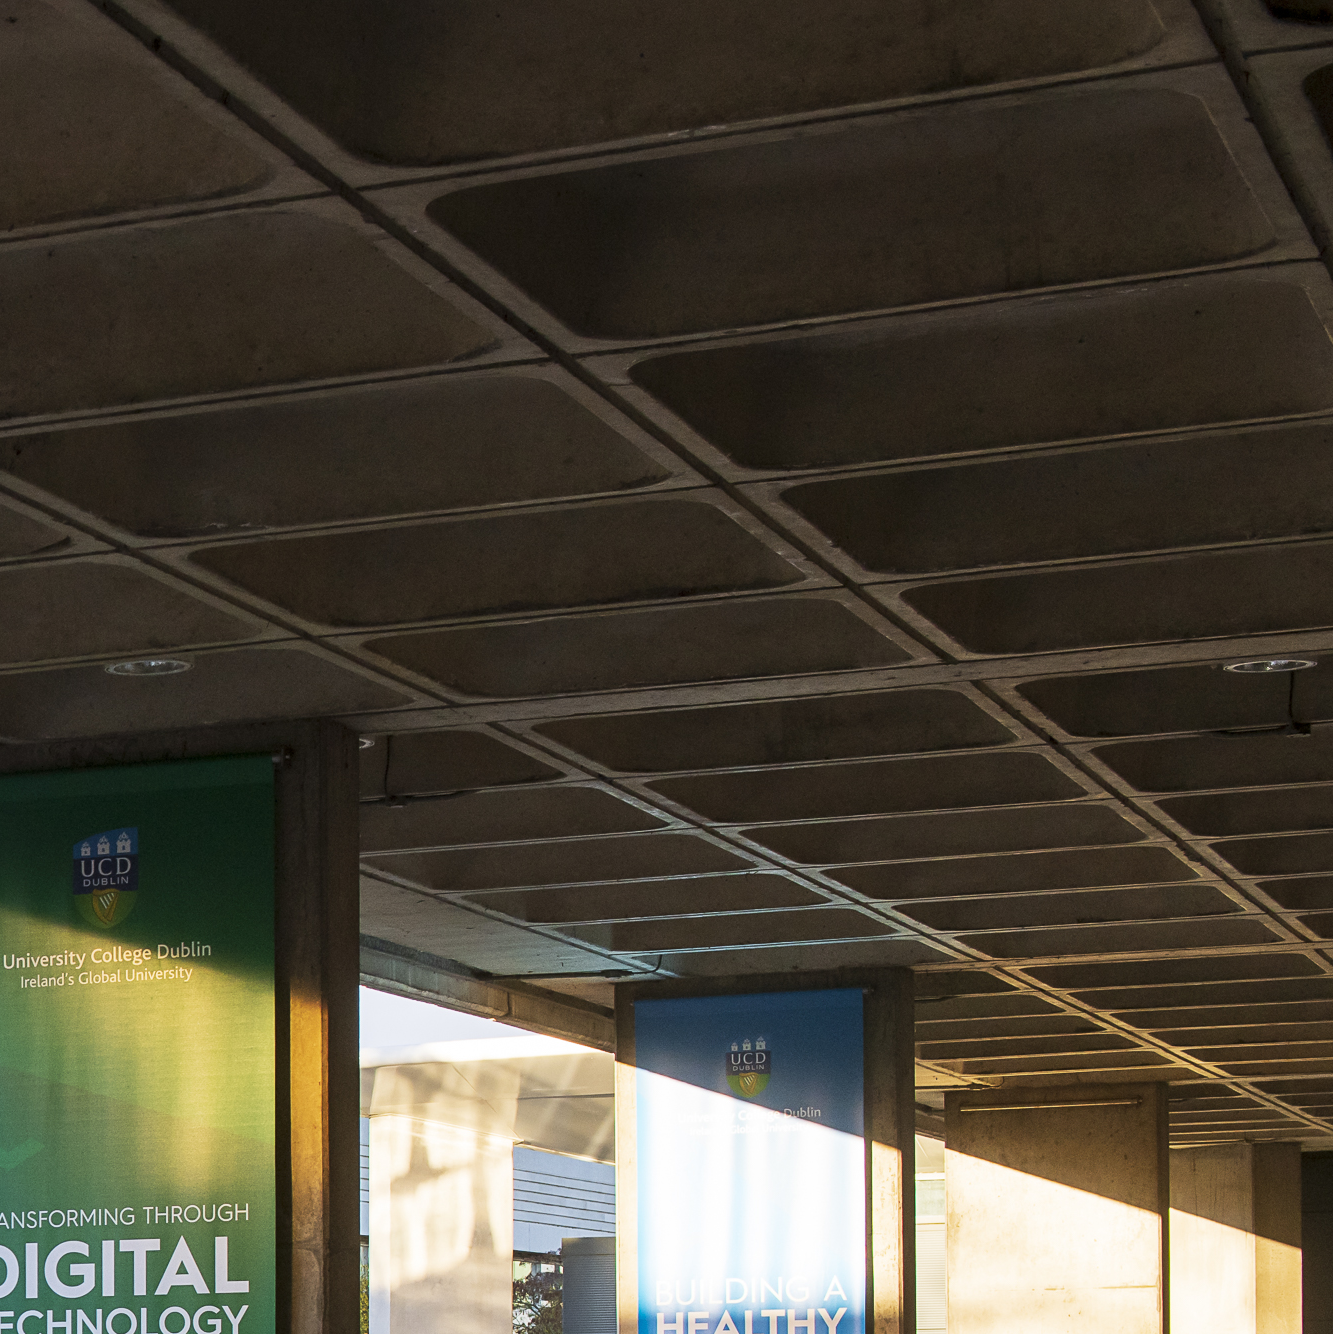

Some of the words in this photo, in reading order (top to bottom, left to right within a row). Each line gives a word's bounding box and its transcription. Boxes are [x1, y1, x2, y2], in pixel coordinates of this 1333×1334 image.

[80, 857, 131, 878] UCD
[83, 876, 129, 887] DUBLIN
[3, 949, 86, 971] University
[90, 946, 152, 965] College
[156, 941, 212, 960] Dublin
[20, 971, 75, 989] Ireland's
[78, 969, 121, 985] Global
[125, 965, 193, 983] University
[730, 1051, 766, 1066] UCD
[732, 1064, 765, 1072] DUBLIN
[783, 1106, 822, 1119] Dublin
[142, 1203, 250, 1225] THROUGH
[655, 1276, 810, 1306] BUILDING
[823, 1275, 849, 1301] A
